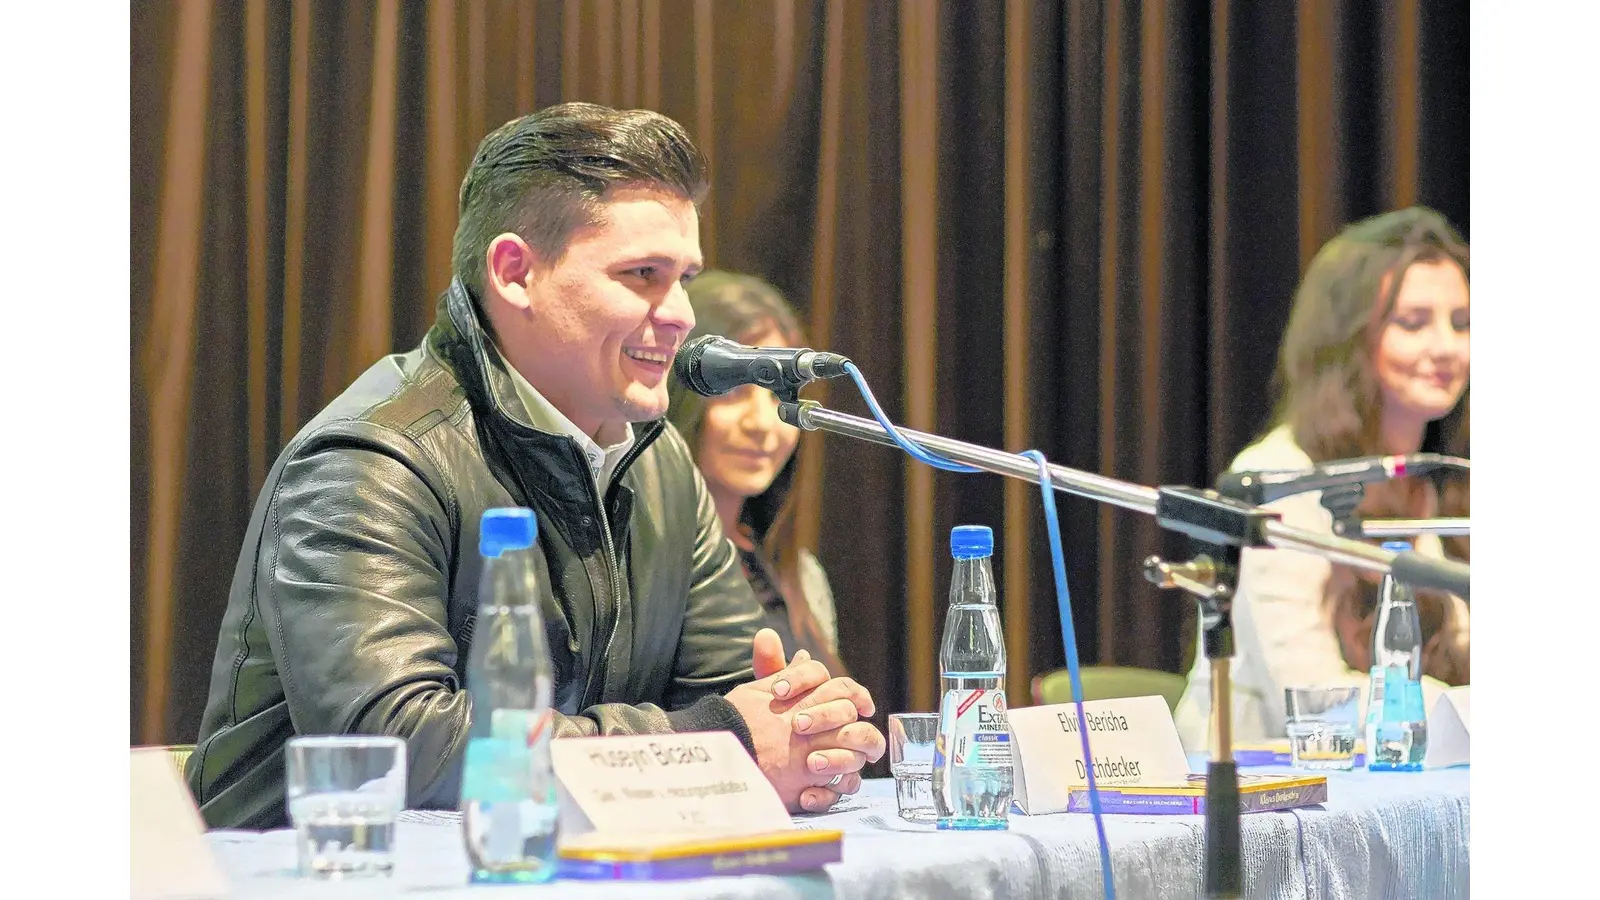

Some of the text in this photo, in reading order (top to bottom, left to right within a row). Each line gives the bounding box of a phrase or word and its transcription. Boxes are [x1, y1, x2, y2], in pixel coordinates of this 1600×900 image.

[1057, 710, 1129, 733] Elvi Berisha
[1075, 756, 1142, 780] Dchdecker
